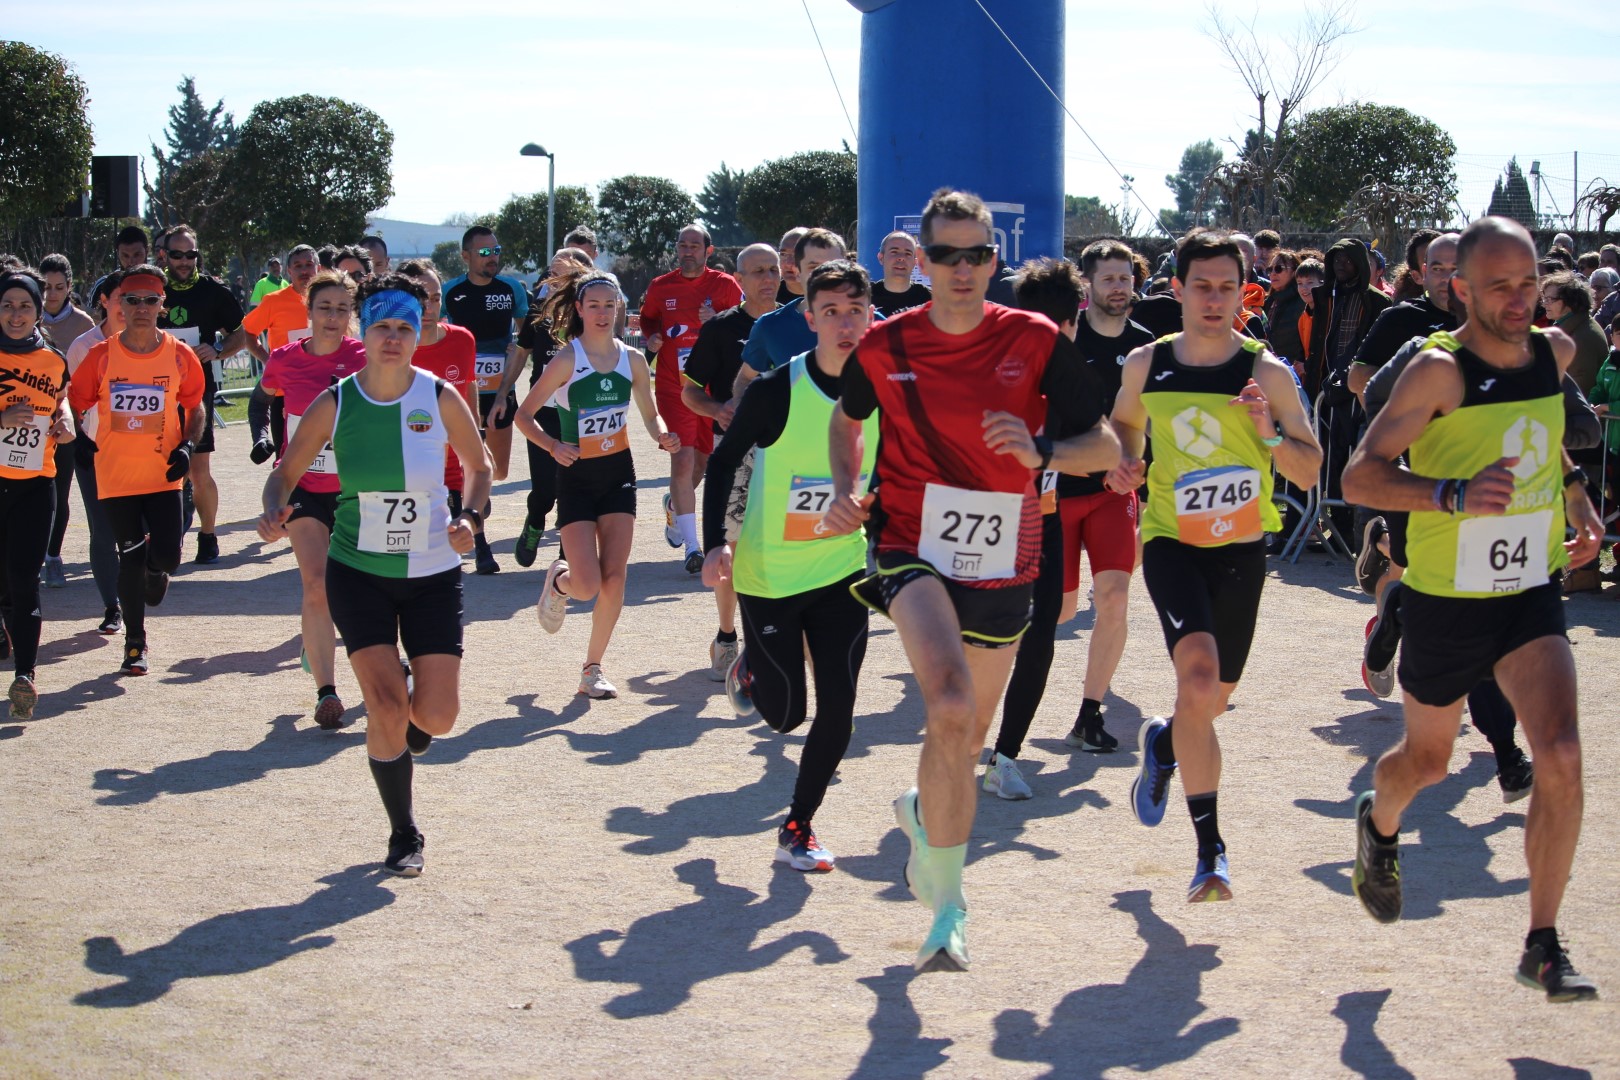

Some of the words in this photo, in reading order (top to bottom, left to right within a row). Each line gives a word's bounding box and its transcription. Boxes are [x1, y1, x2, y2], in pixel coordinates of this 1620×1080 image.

[485, 302, 512, 311] SPORT
[114, 394, 160, 412] 2739
[584, 411, 624, 434] 2747
[8, 451, 28, 464] bnf
[795, 490, 830, 512] 27
[1183, 479, 1252, 511] 2746
[383, 498, 418, 525] 73
[940, 510, 1003, 546] 273
[386, 533, 411, 546] bnf
[951, 555, 983, 573] bnf
[1489, 536, 1528, 571] 64
